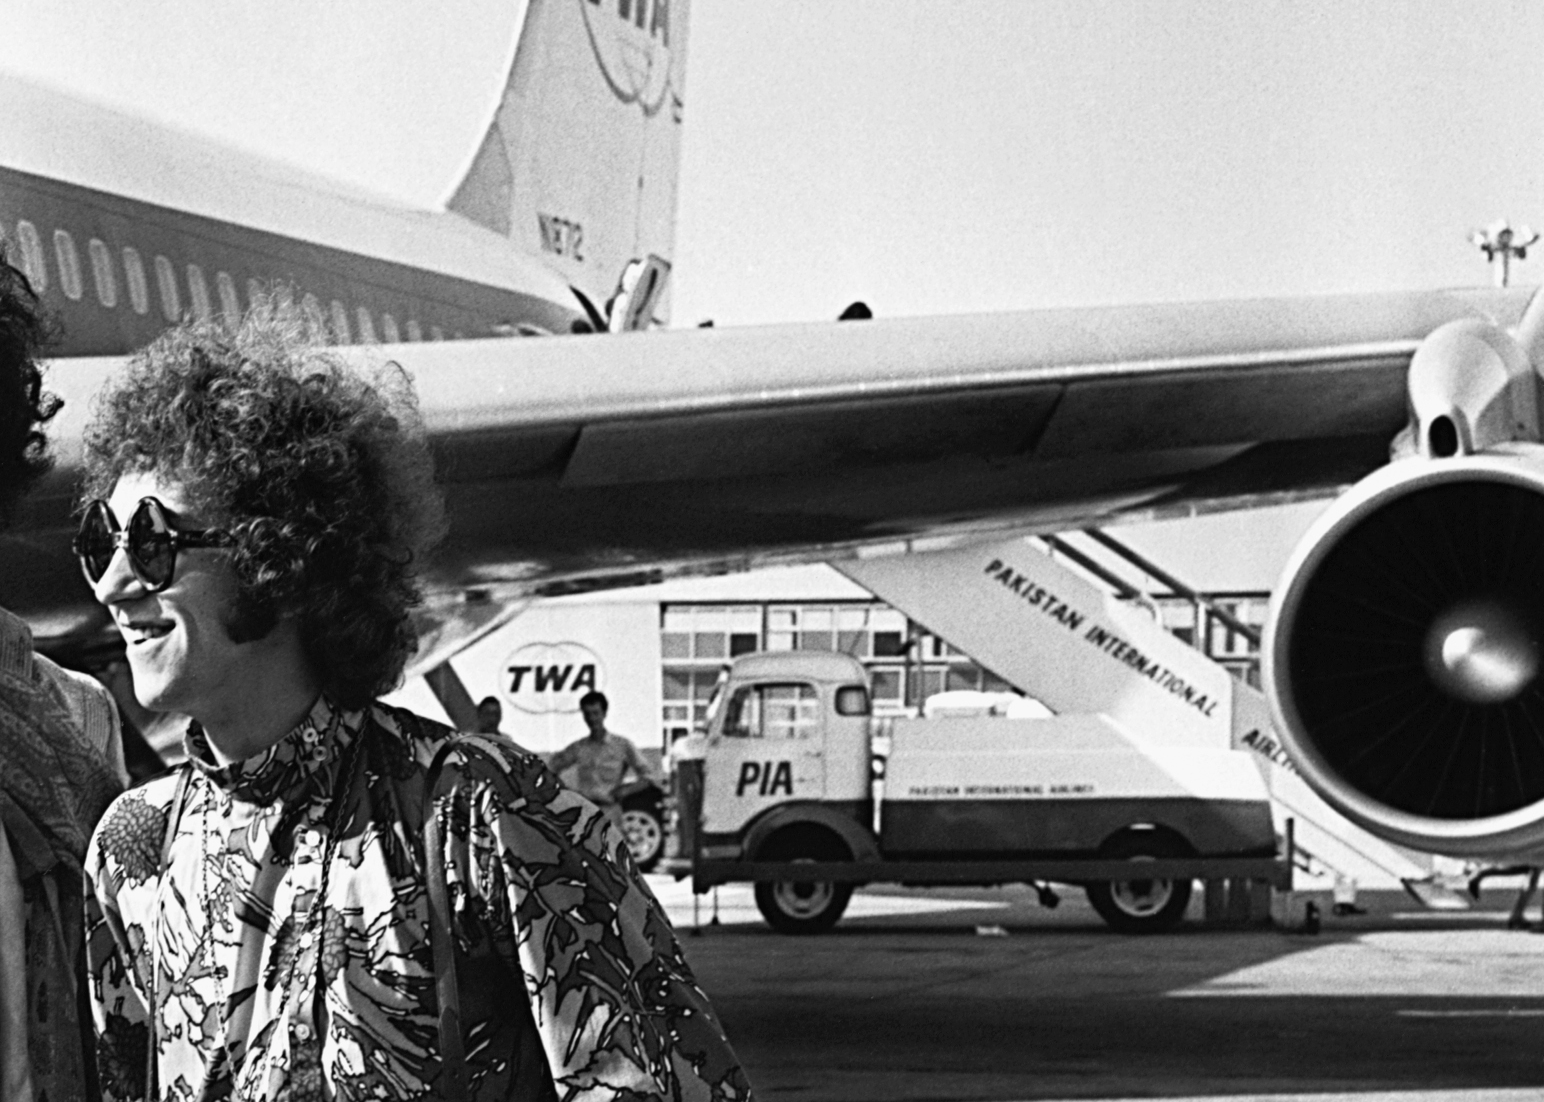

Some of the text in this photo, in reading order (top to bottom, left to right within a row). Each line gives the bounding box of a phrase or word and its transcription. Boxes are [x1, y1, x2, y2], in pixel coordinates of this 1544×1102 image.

[984, 559, 1084, 631] PAKISTAN
[1085, 626, 1218, 717] INTERNATIONAL
[508, 664, 596, 693] TWA
[736, 761, 793, 796] PIA
